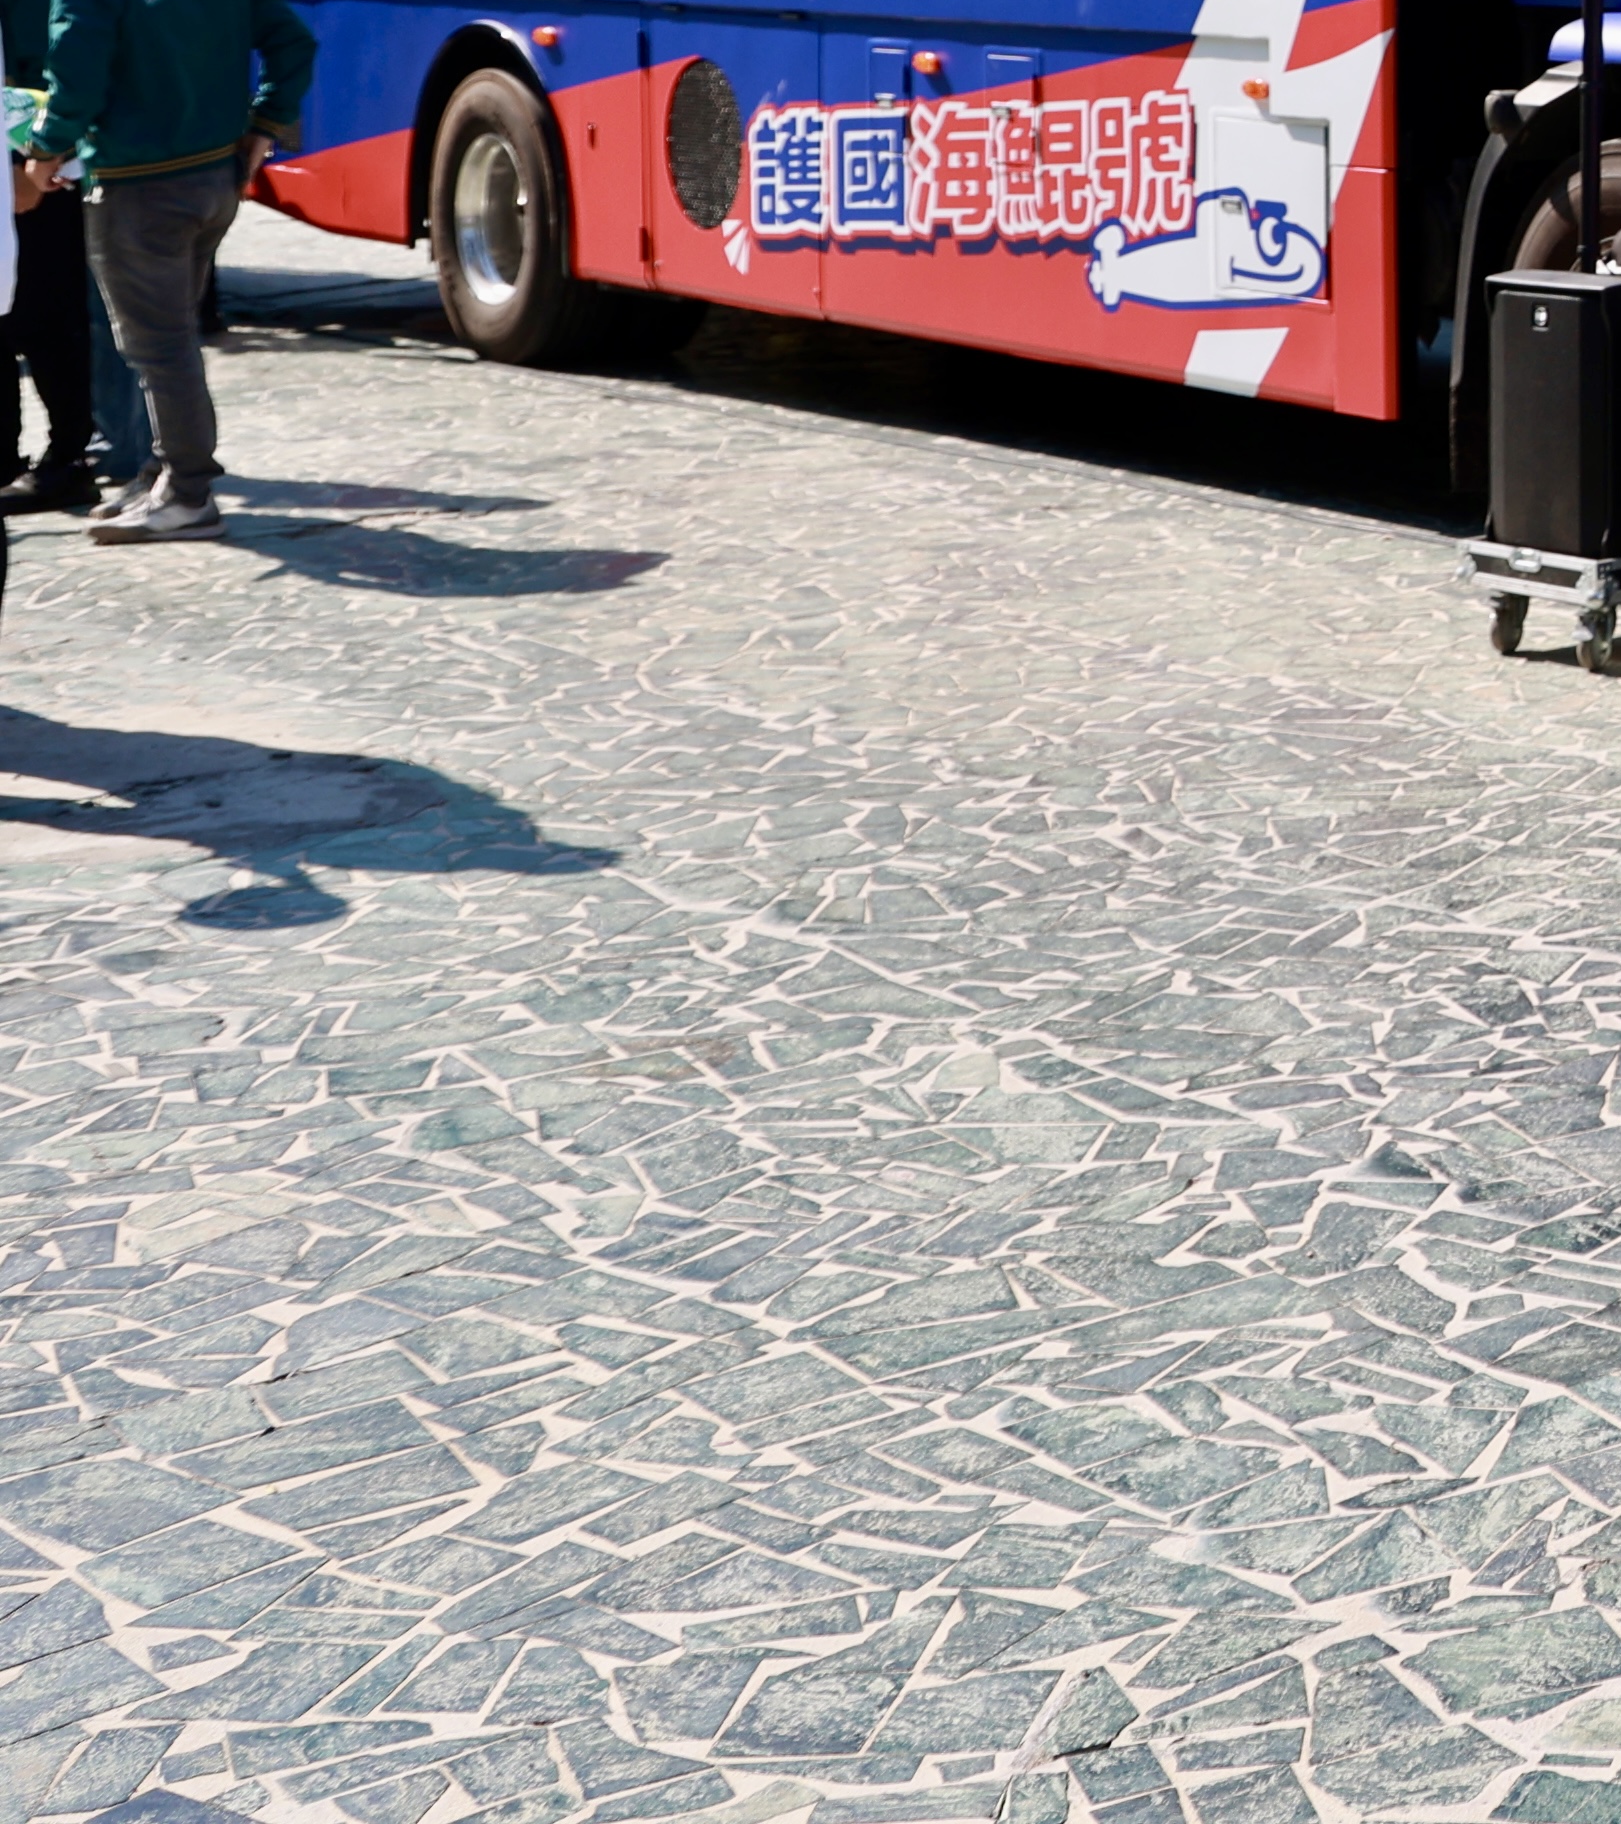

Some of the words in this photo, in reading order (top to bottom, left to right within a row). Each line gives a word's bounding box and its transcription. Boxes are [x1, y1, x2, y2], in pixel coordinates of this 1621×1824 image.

[748, 88, 1197, 240] 護國海鯤號
